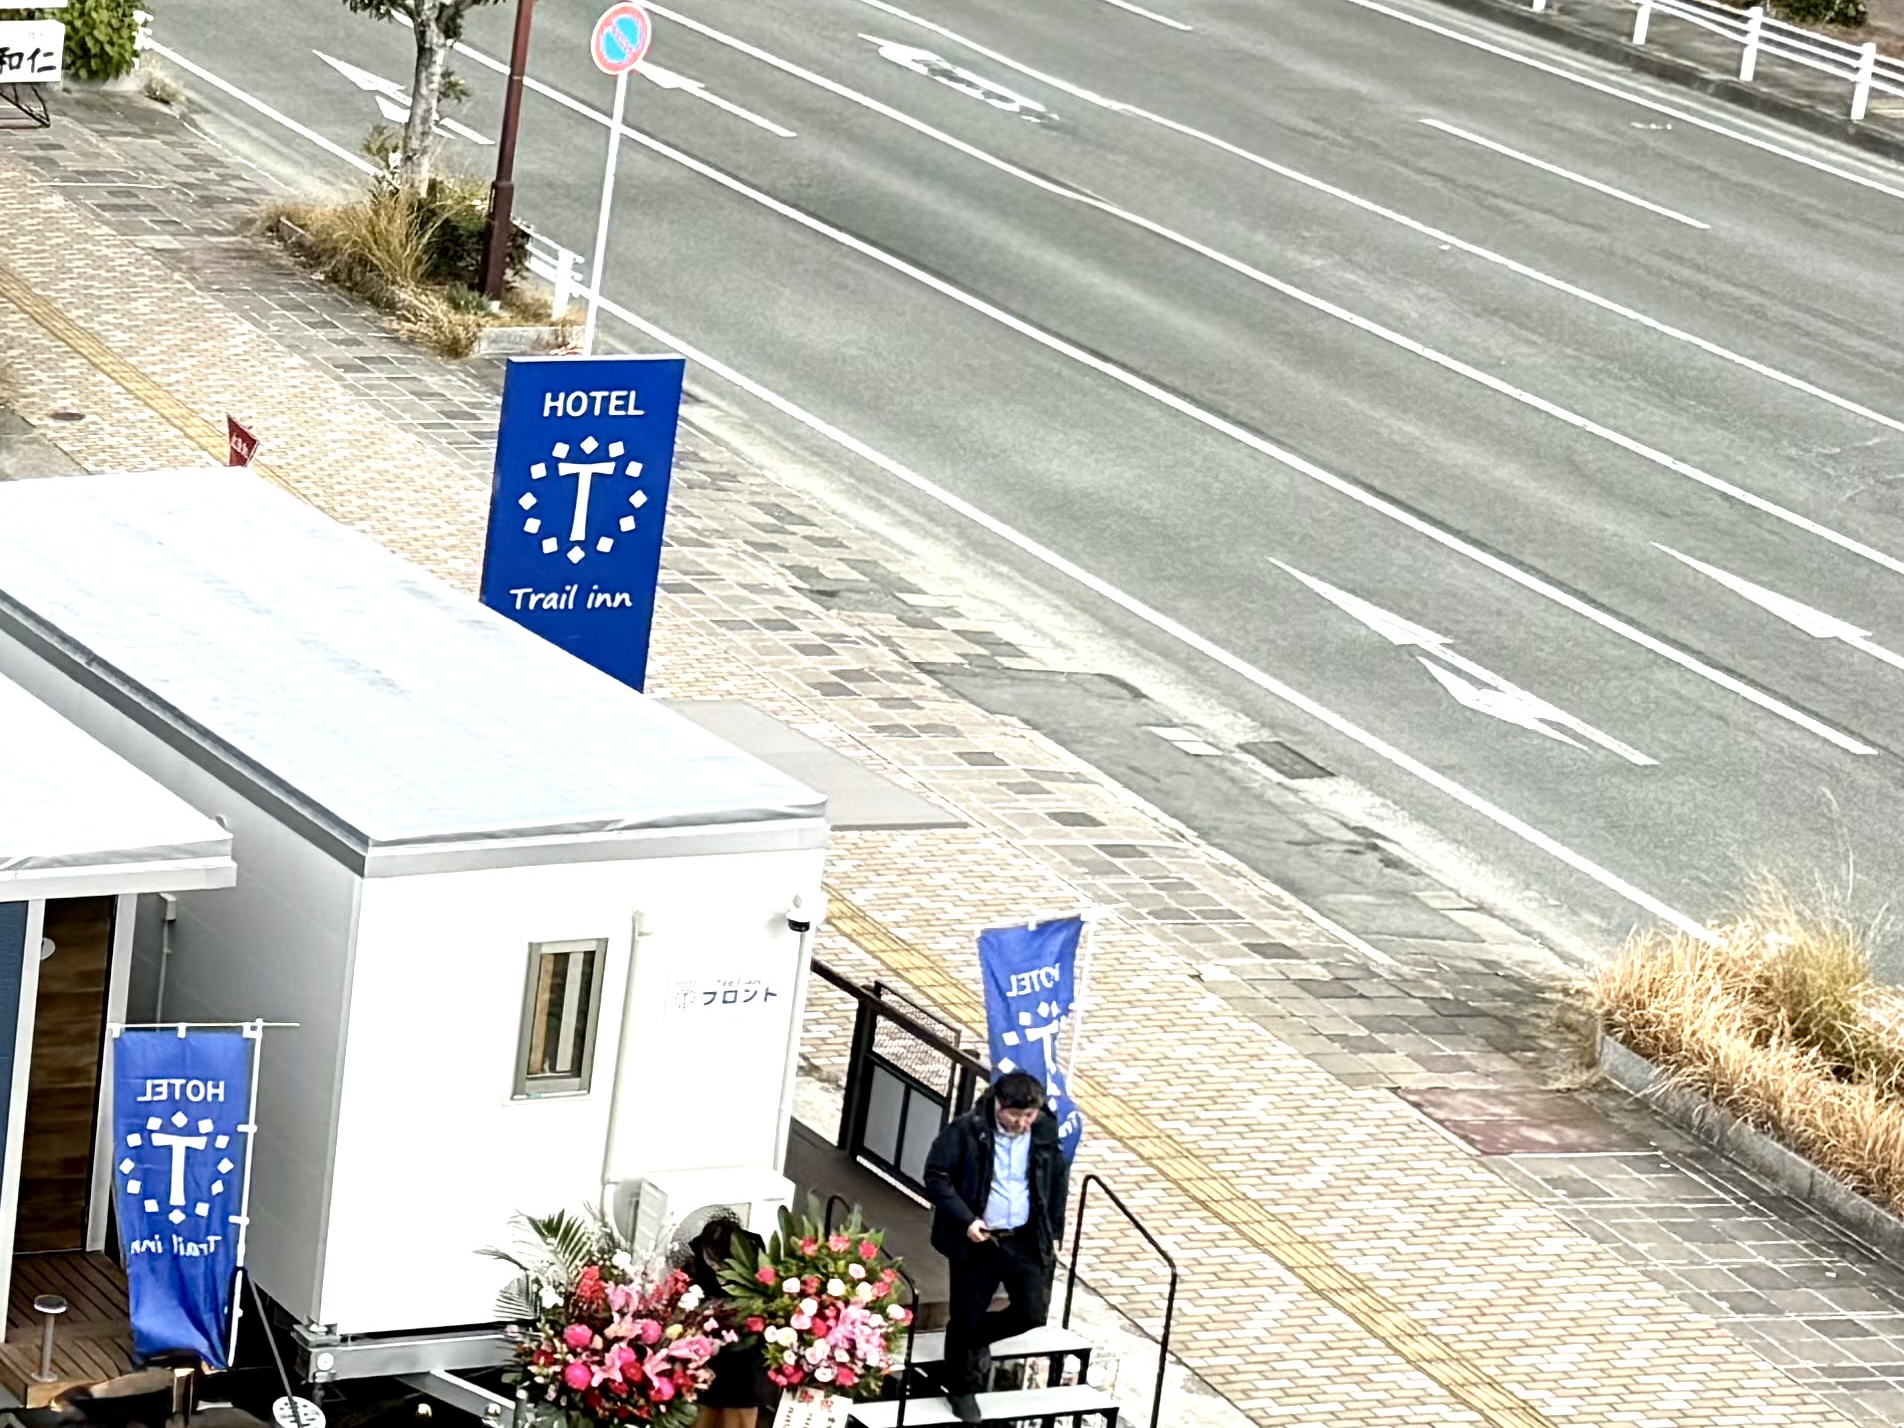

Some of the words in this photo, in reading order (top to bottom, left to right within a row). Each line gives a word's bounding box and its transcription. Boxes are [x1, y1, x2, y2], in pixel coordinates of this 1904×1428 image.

[542, 390, 646, 417] HOTEL
[558, 462, 616, 543] T
[509, 584, 578, 610] Trail
[586, 584, 633, 609] inn
[702, 987, 777, 1006] フロント
